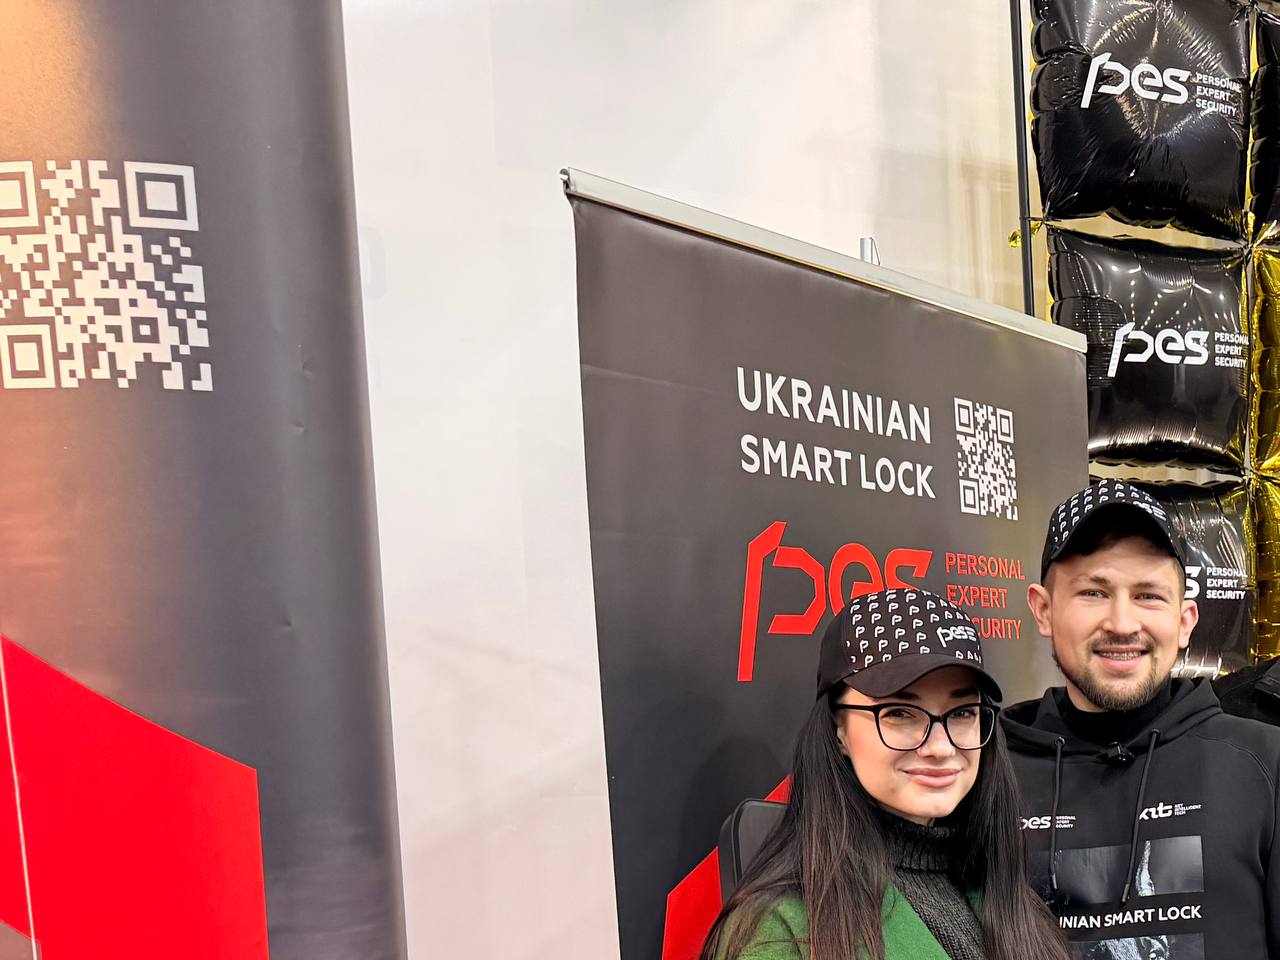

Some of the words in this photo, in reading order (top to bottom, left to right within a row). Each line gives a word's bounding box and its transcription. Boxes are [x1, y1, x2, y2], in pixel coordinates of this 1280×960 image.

[1080, 52, 1191, 109] pes
[1195, 73, 1242, 93] PERSONAL
[1196, 86, 1231, 101] EXPERT
[1195, 99, 1238, 117] SECURITY
[1214, 332, 1249, 345] PERSONAL
[1107, 322, 1210, 377] pes
[1214, 345, 1243, 356] EXPERT
[1214, 358, 1247, 368] SECURITY
[737, 366, 931, 444] UKRAINIAN
[741, 434, 852, 486] SMART
[859, 453, 936, 498] LOCK
[945, 552, 1026, 581] PERSONAL
[1206, 567, 1248, 577] PERSONAL
[1206, 578, 1238, 588] EXPERT
[946, 584, 1009, 609] EXPERT
[1206, 590, 1246, 599] SECURITY
[937, 626, 967, 647] pes
[973, 618, 1022, 640] CURITY
[1104, 909, 1155, 927] SMART
[1158, 905, 1202, 921] LOCK
